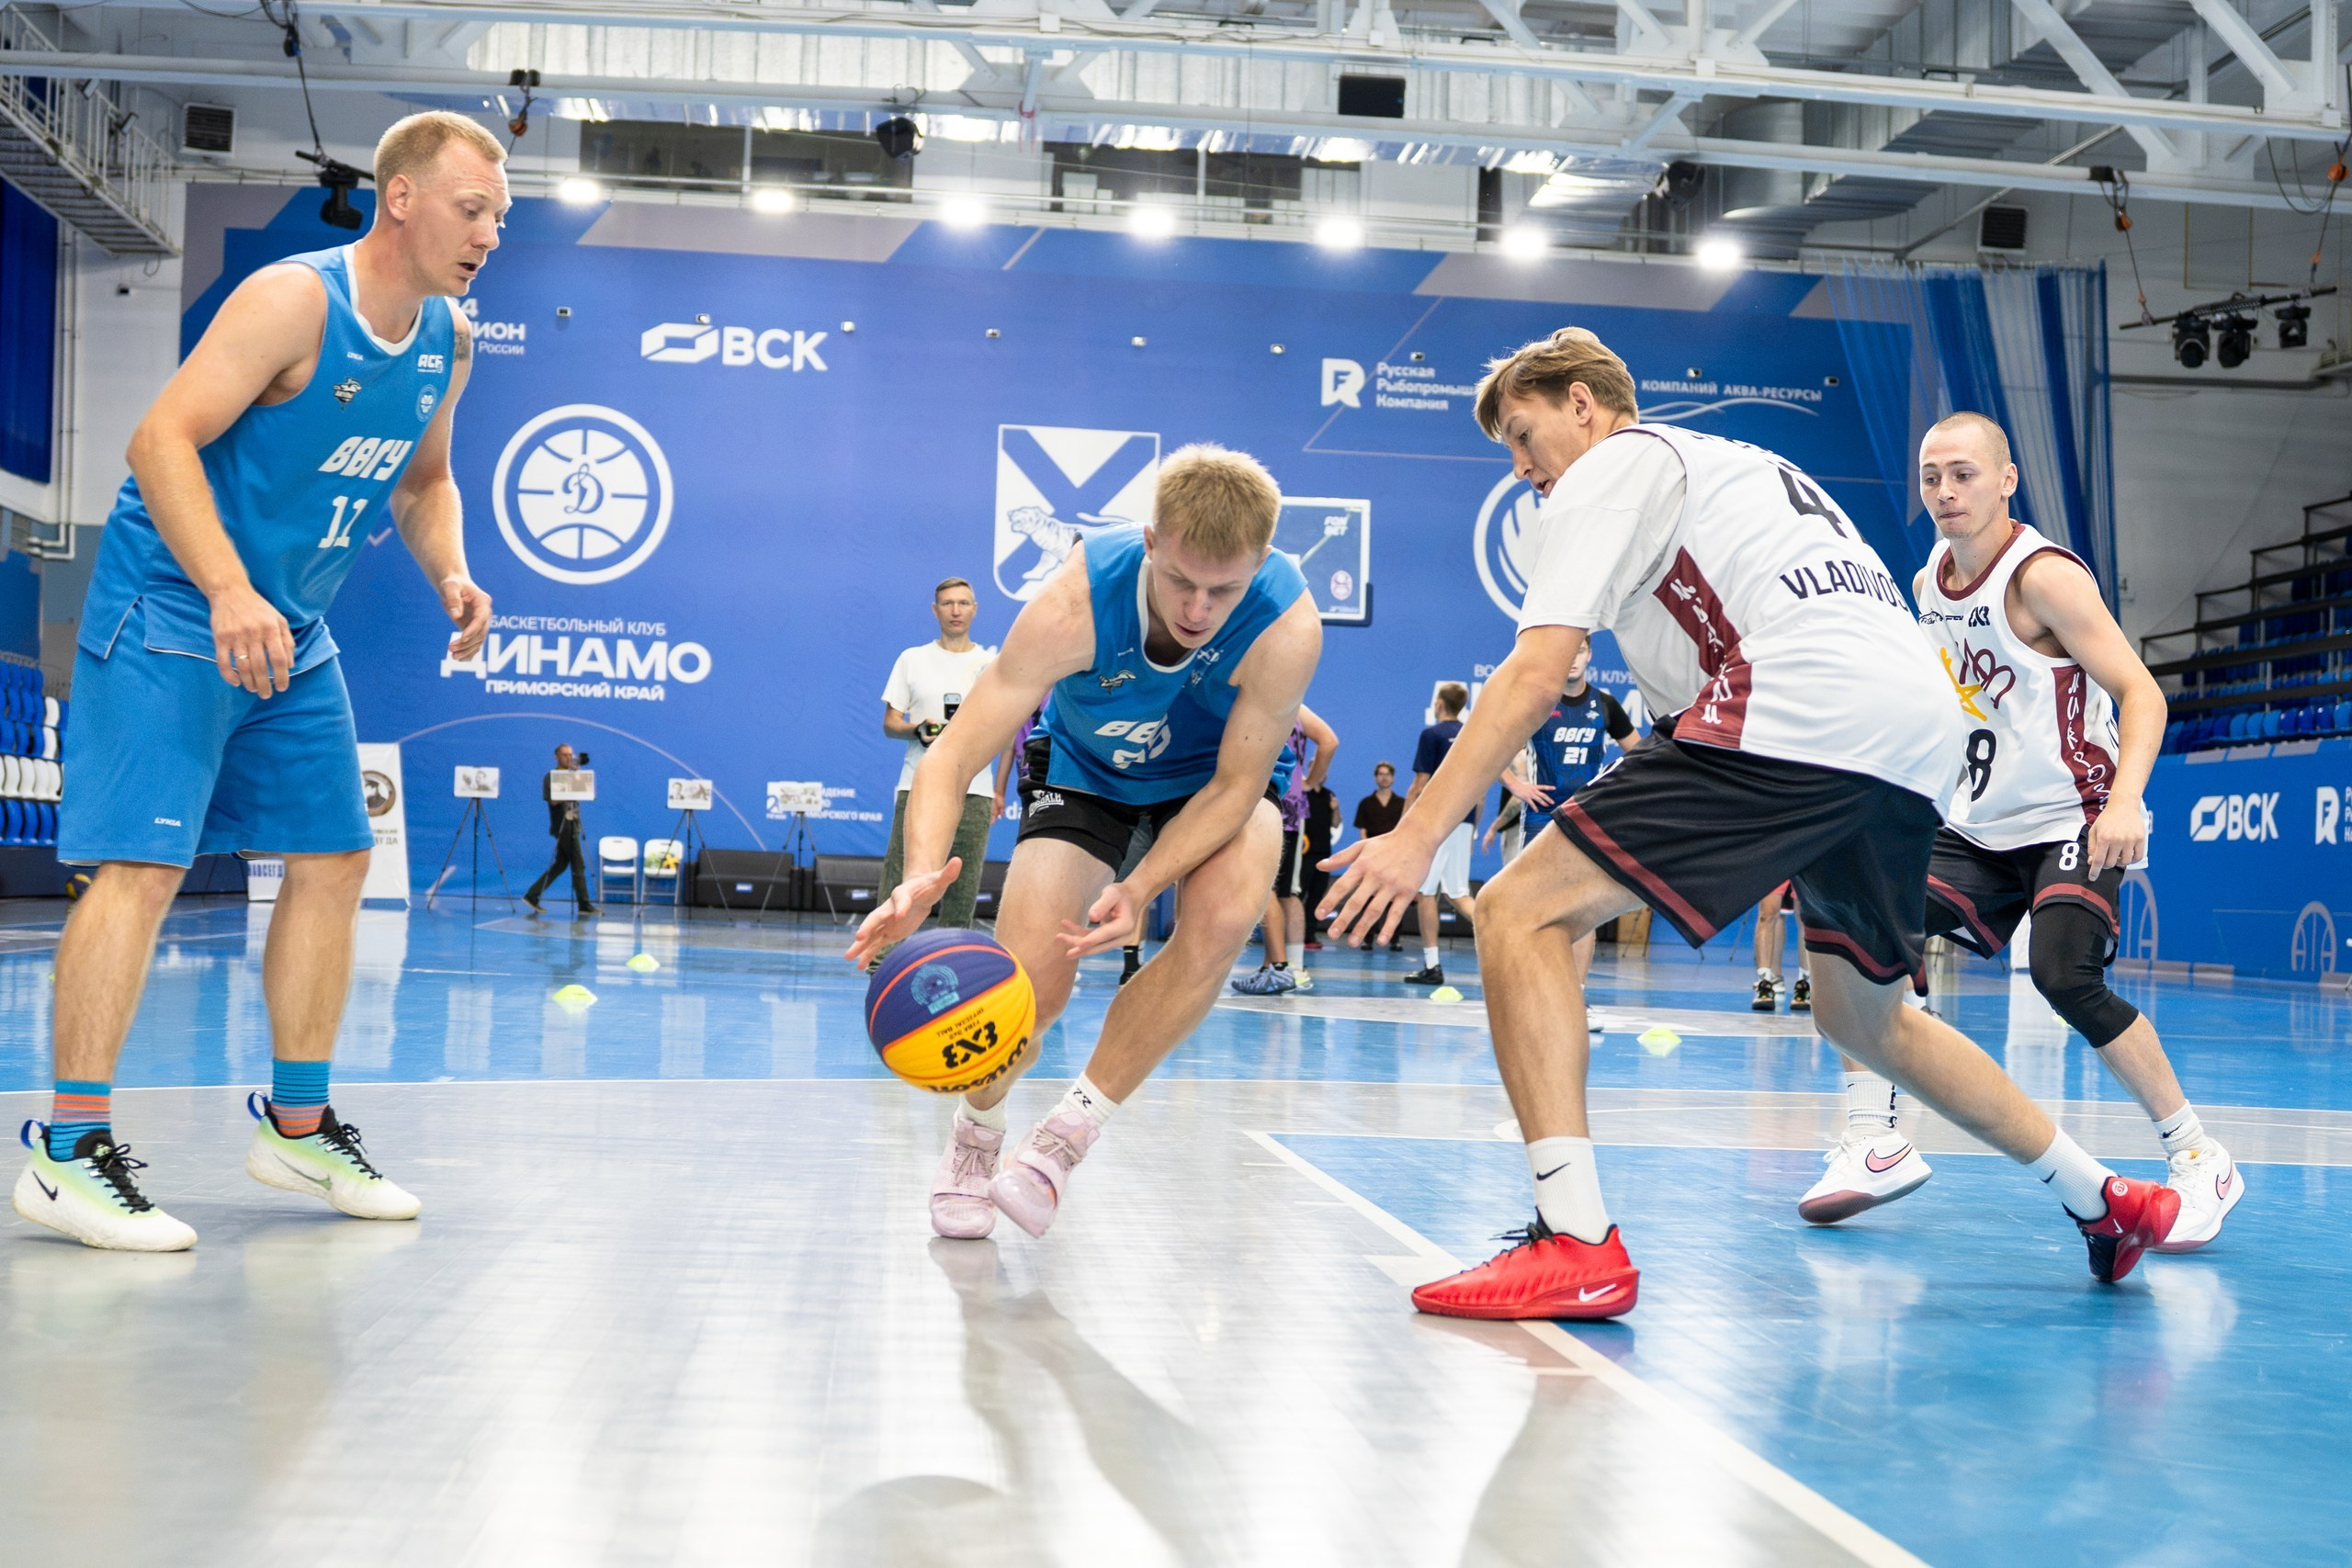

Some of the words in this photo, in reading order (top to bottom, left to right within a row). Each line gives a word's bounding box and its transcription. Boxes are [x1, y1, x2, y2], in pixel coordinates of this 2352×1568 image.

[479, 340, 525, 355] России
[1376, 361, 1436, 378] Русская
[1376, 377, 1476, 397] Рыбопромыш
[1641, 379, 1718, 395] КОМПАНИЙ
[1723, 384, 1823, 402] АКВА-РЕСУРСЫ
[1376, 393, 1450, 411] Компания
[317, 435, 413, 481] ВВГУ
[489, 615, 624, 634] БАСКЕТБОЛЬНЫЙ
[627, 621, 667, 637] КЛУБ
[439, 631, 713, 684] ДИНАМО
[485, 679, 611, 698] ПРИМОРСКИЙ
[614, 684, 665, 702] КРАЙ
[1563, 746, 1589, 765] 21
[2058, 841, 2080, 871] 8
